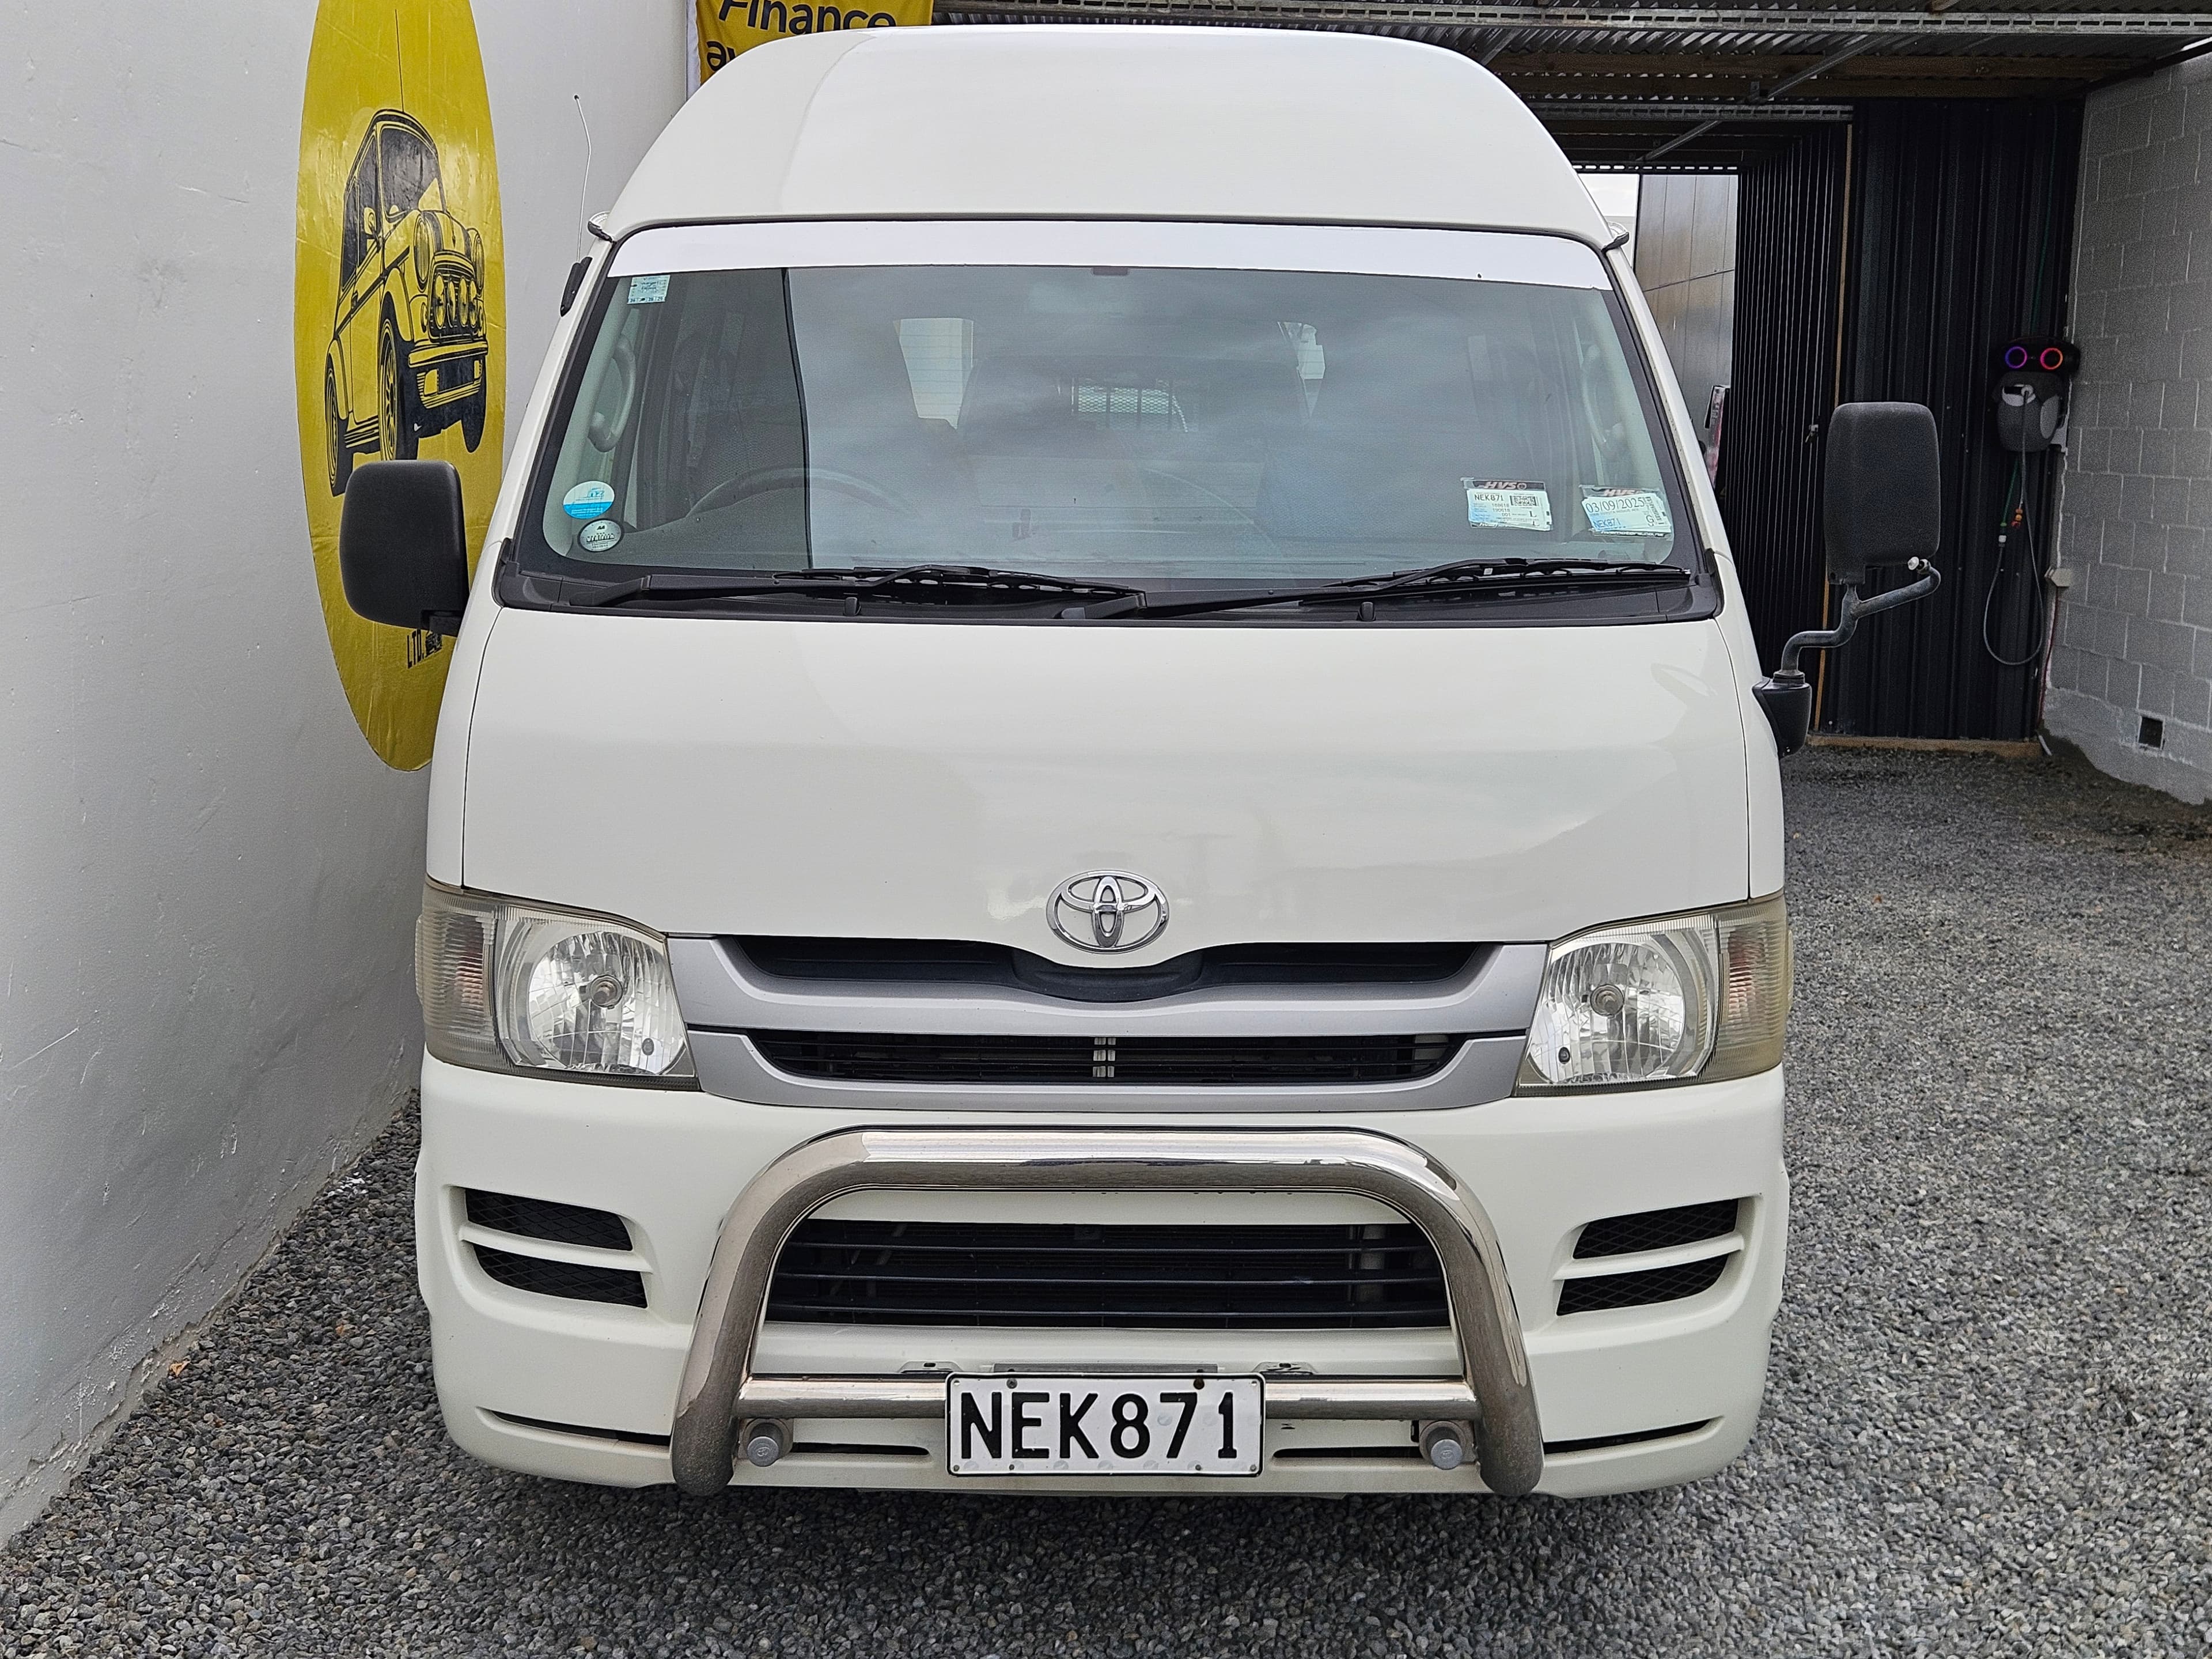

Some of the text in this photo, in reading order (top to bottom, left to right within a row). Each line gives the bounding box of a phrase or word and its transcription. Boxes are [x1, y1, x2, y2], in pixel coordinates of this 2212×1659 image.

[719, 0, 896, 35] Finance
[1483, 482, 1518, 490] HVS
[1585, 497, 1645, 513] 03/09/2025
[1593, 518, 1622, 529] NEK871
[961, 1392, 1237, 1459] NEK871
